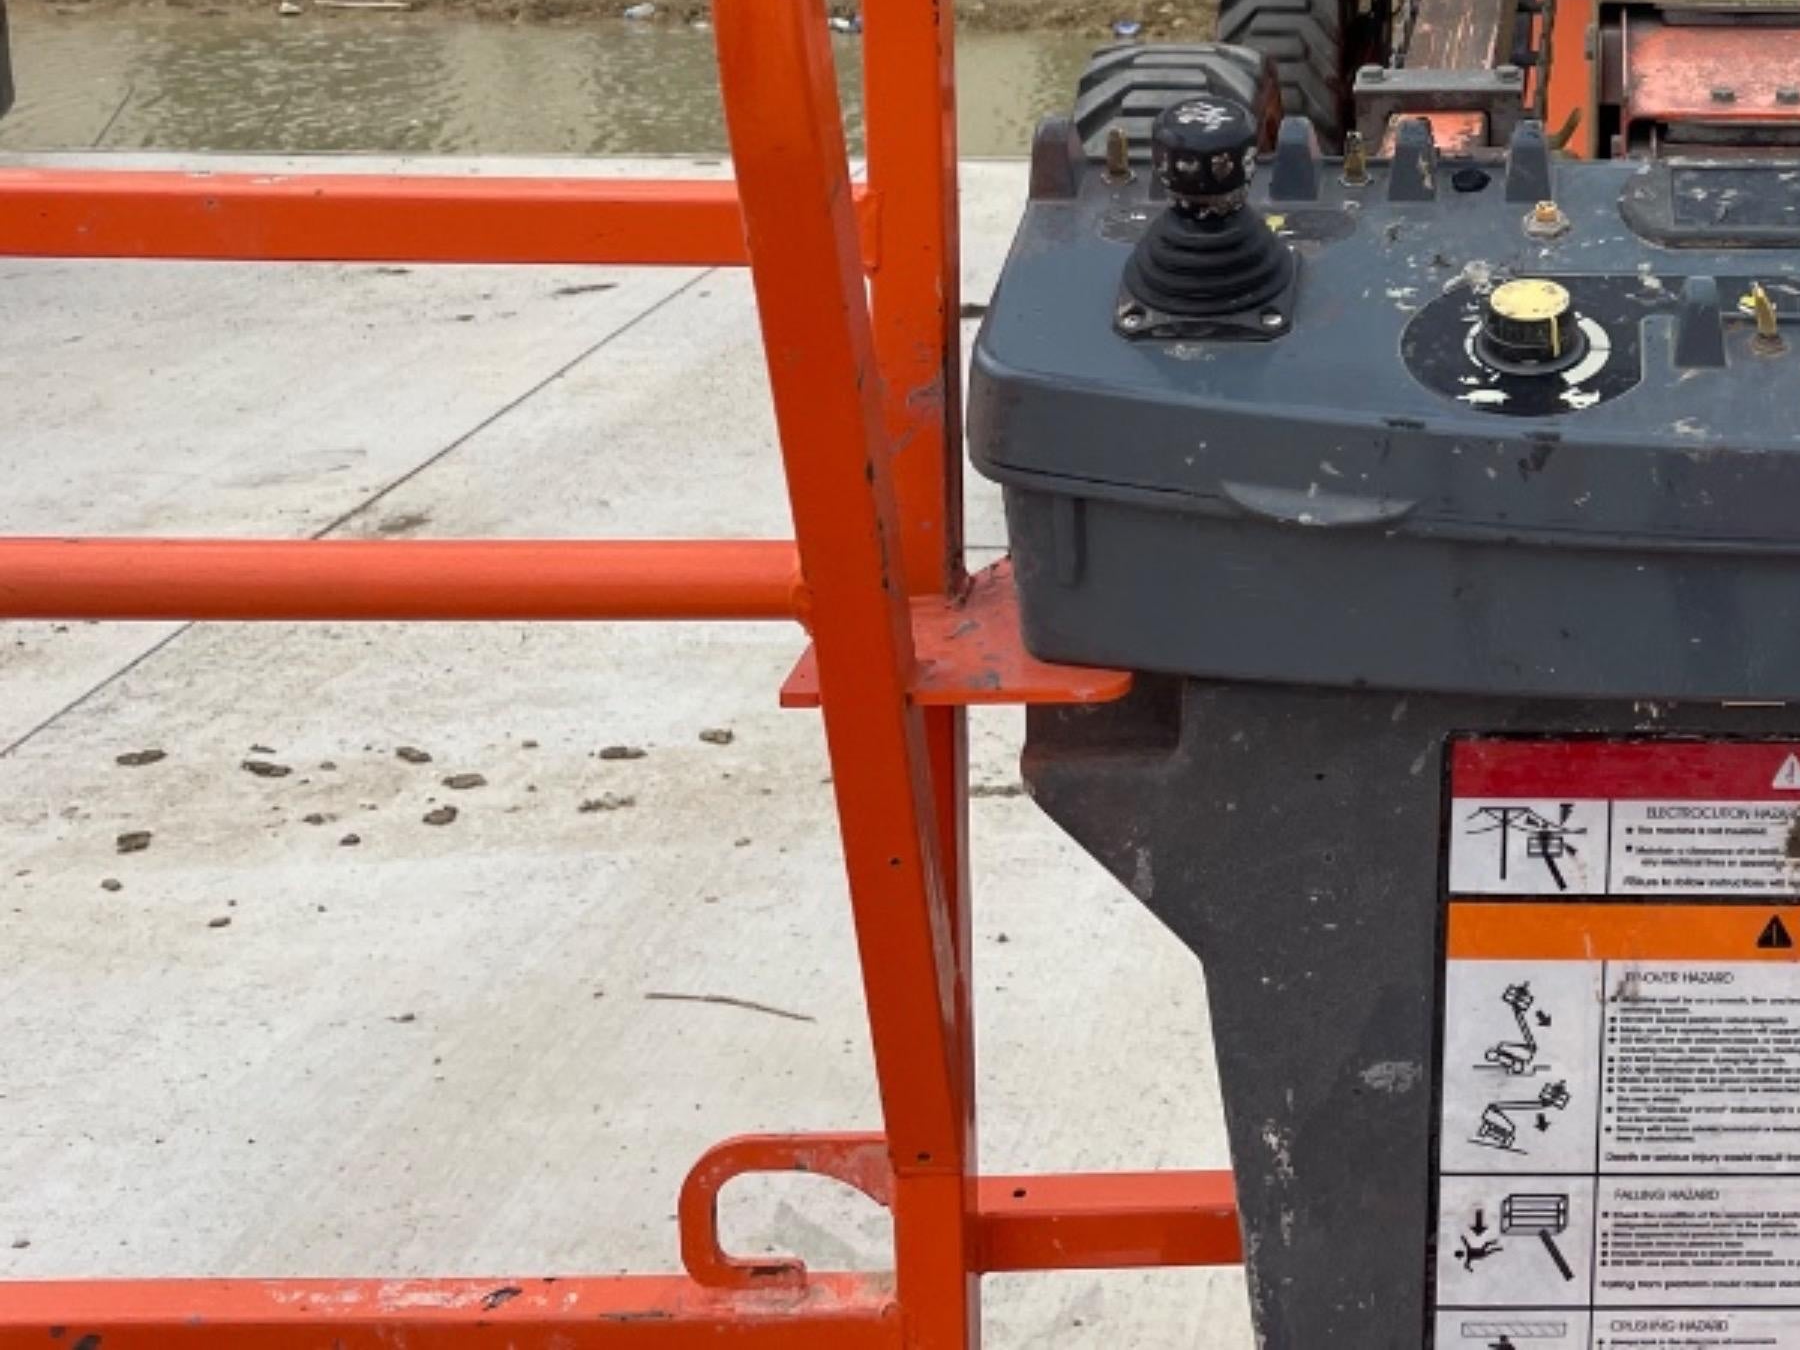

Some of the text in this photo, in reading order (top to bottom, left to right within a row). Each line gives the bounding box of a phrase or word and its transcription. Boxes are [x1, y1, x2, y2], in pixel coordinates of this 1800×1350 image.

[1646, 806, 1750, 820] ELECTROCUTION
[1683, 971, 1735, 985] HAZARD
[1613, 1189, 1720, 1201] FALLING HAZARD
[1610, 1319, 1729, 1332] CRUSHING HAZARD
